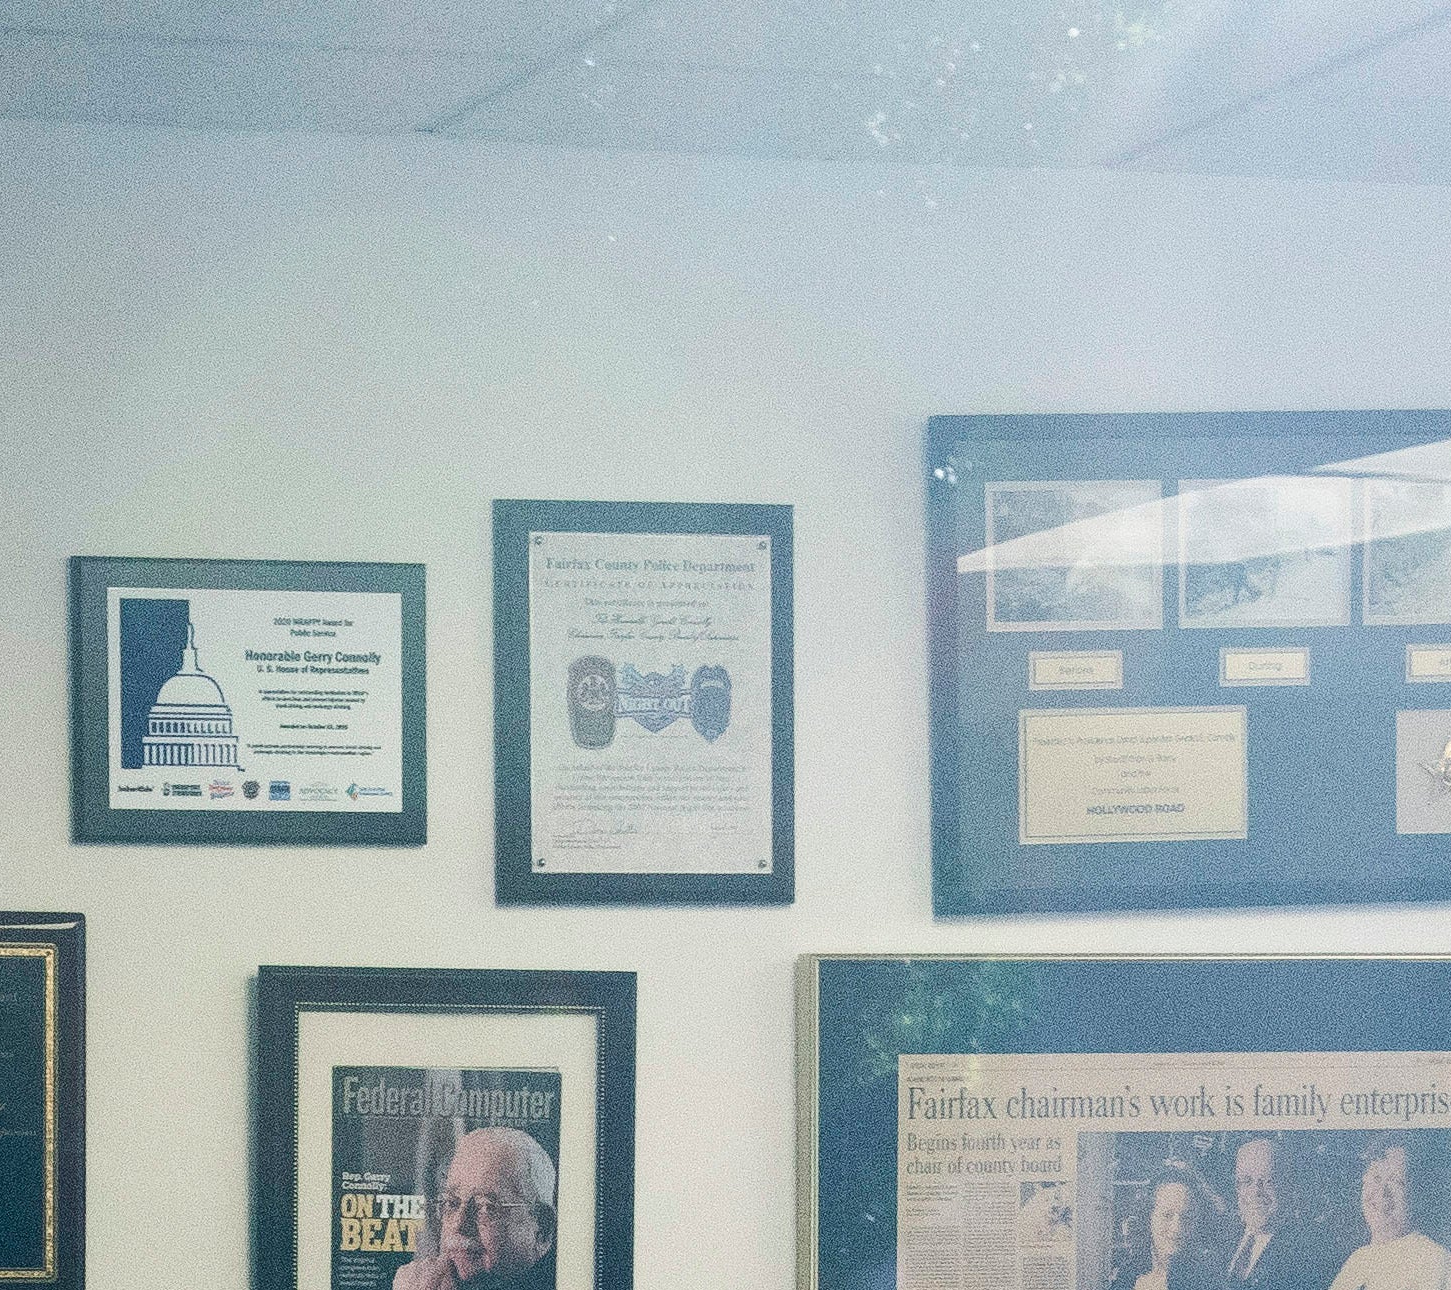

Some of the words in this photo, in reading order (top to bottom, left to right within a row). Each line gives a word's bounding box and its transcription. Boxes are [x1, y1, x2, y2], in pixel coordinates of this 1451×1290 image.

[545, 557, 591, 572] Fairfax
[594, 558, 639, 573] County
[642, 559, 679, 573] Police
[682, 560, 755, 574] Department
[245, 649, 301, 662] Honorable
[303, 650, 333, 664] Gerry
[334, 651, 382, 666] Connolly
[1248, 659, 1283, 675] During
[1086, 804, 1153, 816] HOLLYWOOD
[1155, 803, 1185, 814] ROAD
[342, 1075, 432, 1117] Federal
[439, 1080, 556, 1125] Computer
[907, 1086, 998, 1121] Fairfax
[1005, 1085, 1141, 1119] chairman's
[1148, 1084, 1216, 1118] work
[1225, 1084, 1245, 1118] is
[1253, 1083, 1332, 1123] family
[906, 1132, 957, 1155] Begins
[961, 1132, 1006, 1151] fourth
[1009, 1136, 1042, 1154] year
[1045, 1136, 1062, 1151] as
[906, 1157, 943, 1175] chair
[947, 1156, 963, 1175] of
[965, 1159, 1017, 1177] county
[1021, 1156, 1063, 1174] board
[341, 1171, 361, 1184] Rep.
[363, 1172, 392, 1184] Gerry
[340, 1193, 374, 1219] ON
[376, 1194, 426, 1219] THE
[340, 1219, 420, 1252] BEAT
